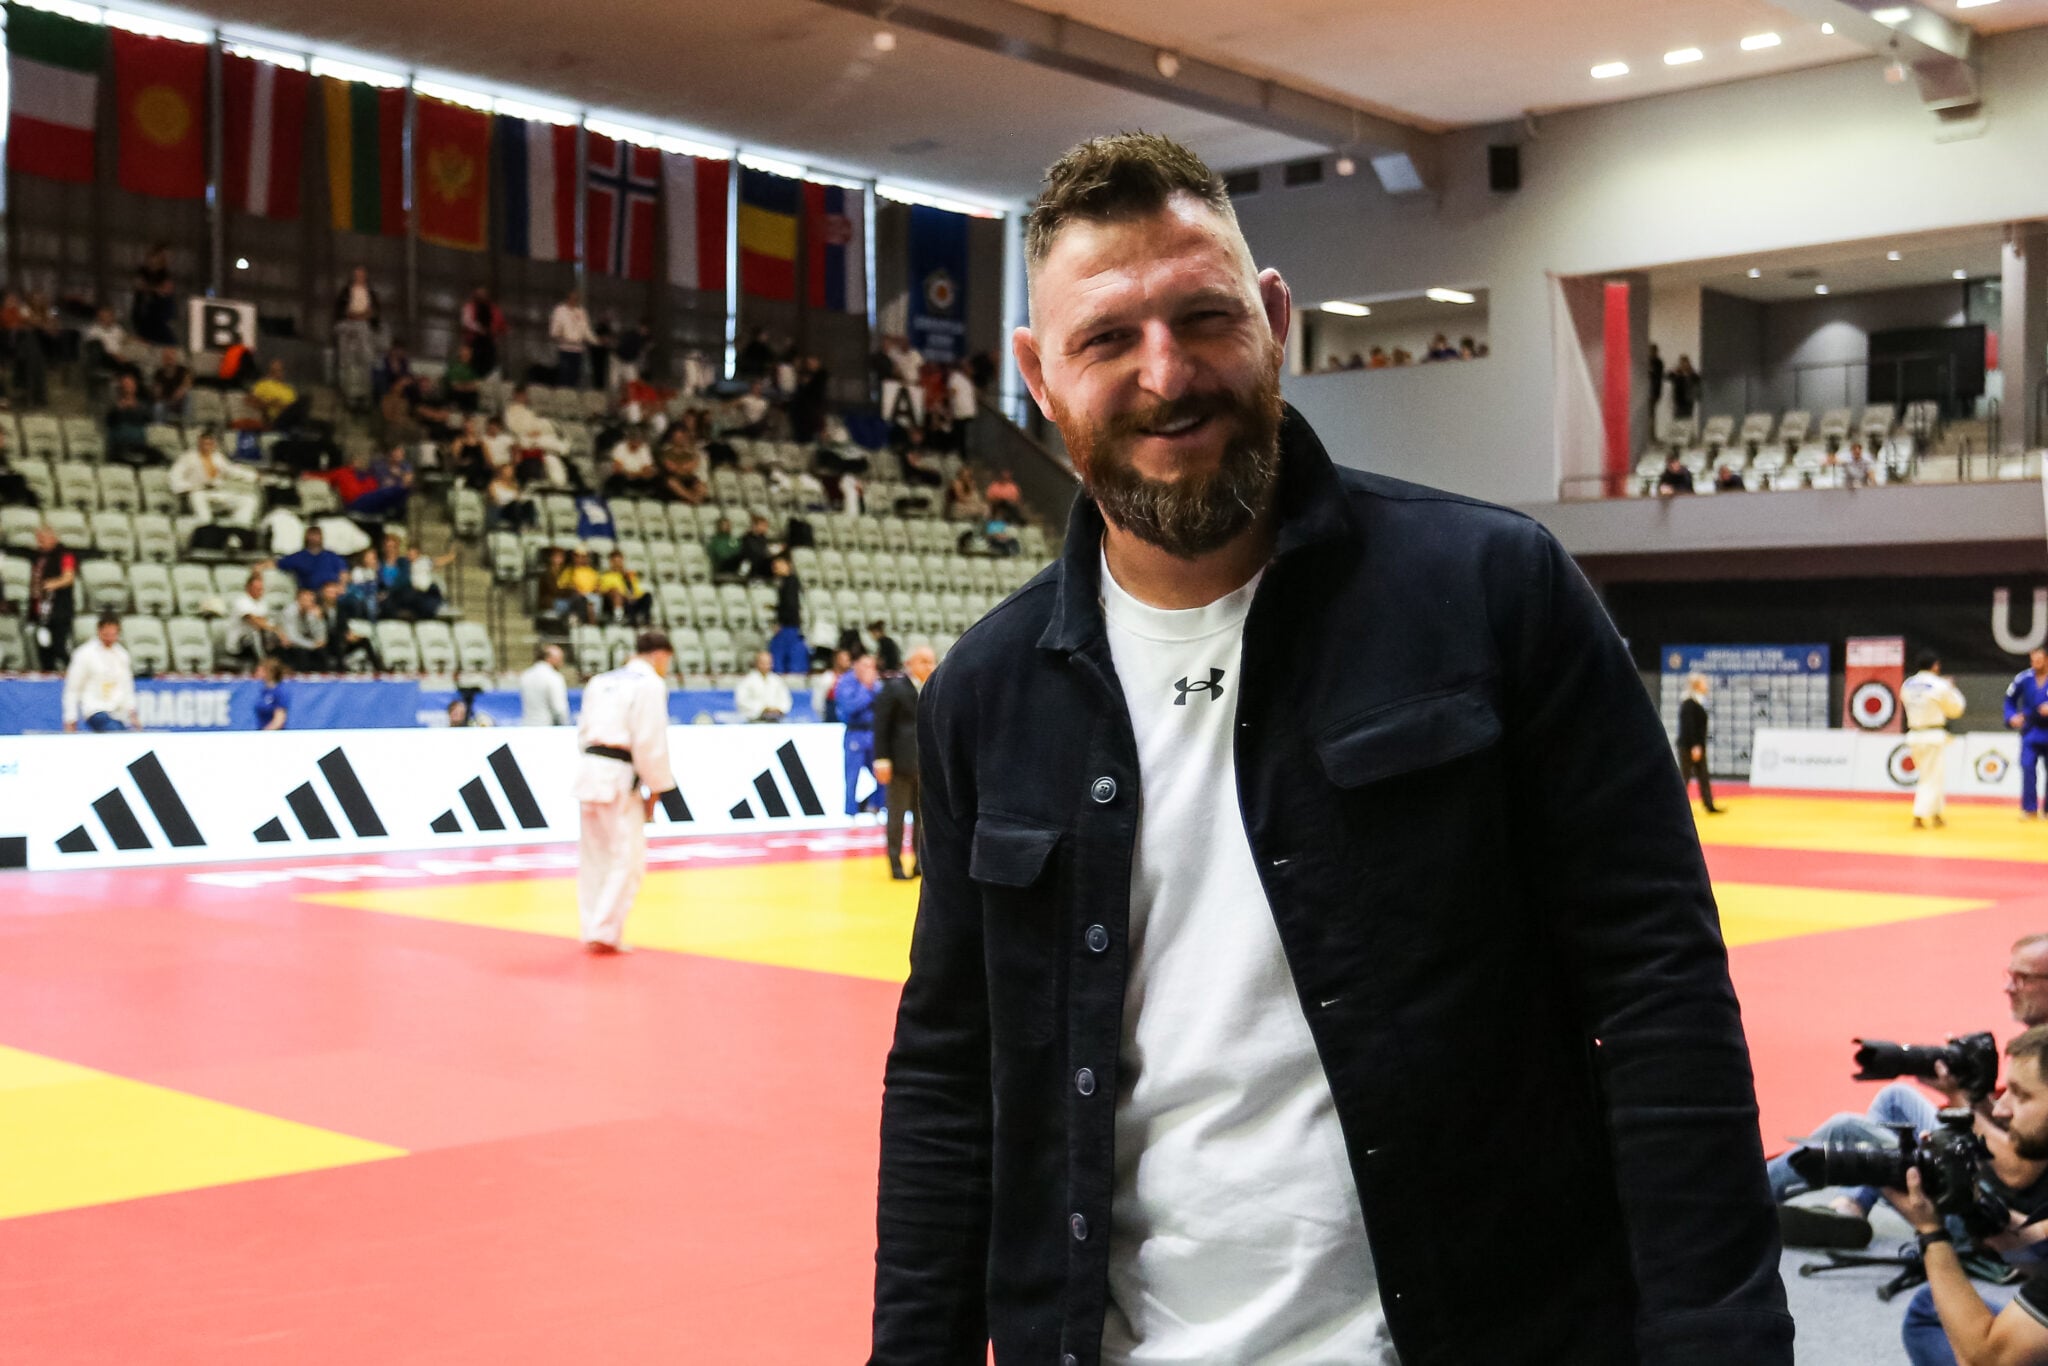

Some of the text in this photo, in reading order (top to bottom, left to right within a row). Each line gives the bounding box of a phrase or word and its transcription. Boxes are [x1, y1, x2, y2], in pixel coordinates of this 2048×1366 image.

[204, 305, 241, 350] B
[893, 386, 917, 426] A
[137, 690, 231, 727] RAGUE
